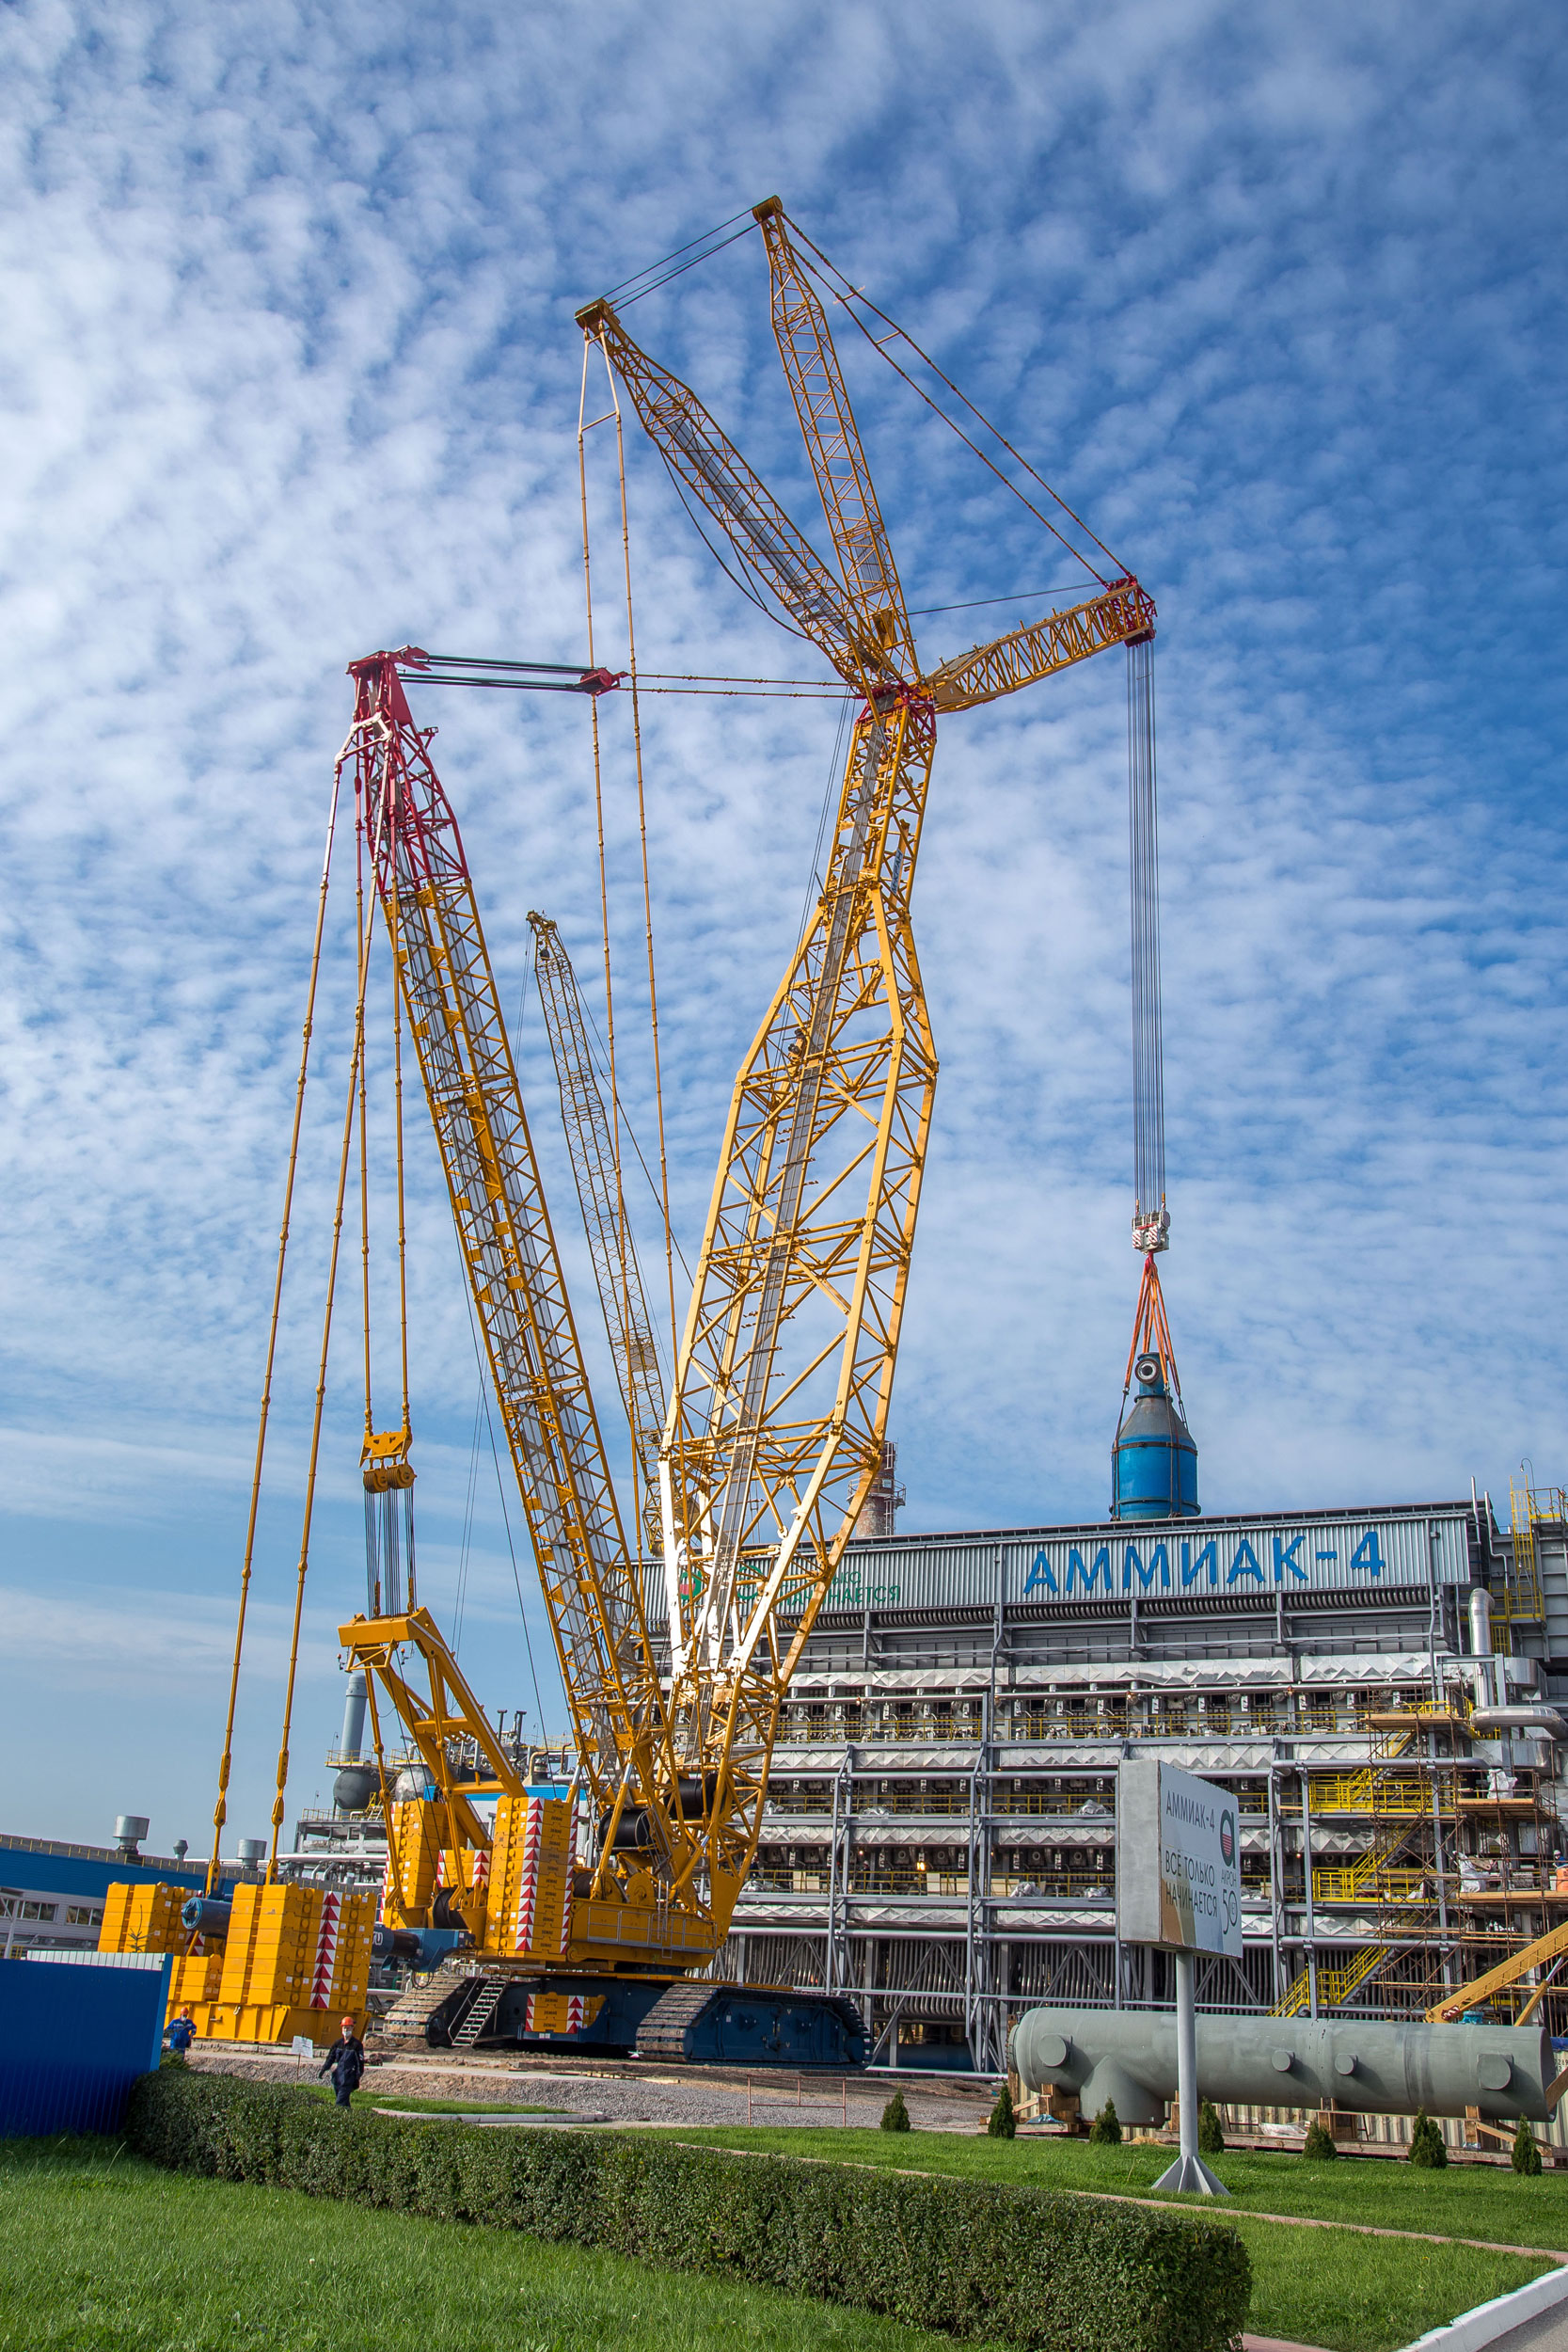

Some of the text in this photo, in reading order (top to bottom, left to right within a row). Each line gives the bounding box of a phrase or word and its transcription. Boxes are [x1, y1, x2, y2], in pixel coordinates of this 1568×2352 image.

[1023, 1531, 1386, 1594] АММИАК-4
[1166, 1789, 1214, 1833] АММИАК-4
[1165, 1849, 1214, 1886] ВСЁ ТОЛЬКО
[1166, 1882, 1217, 1917] НАЧИНАЕТСЯ
[1223, 1888, 1238, 1934] 50
